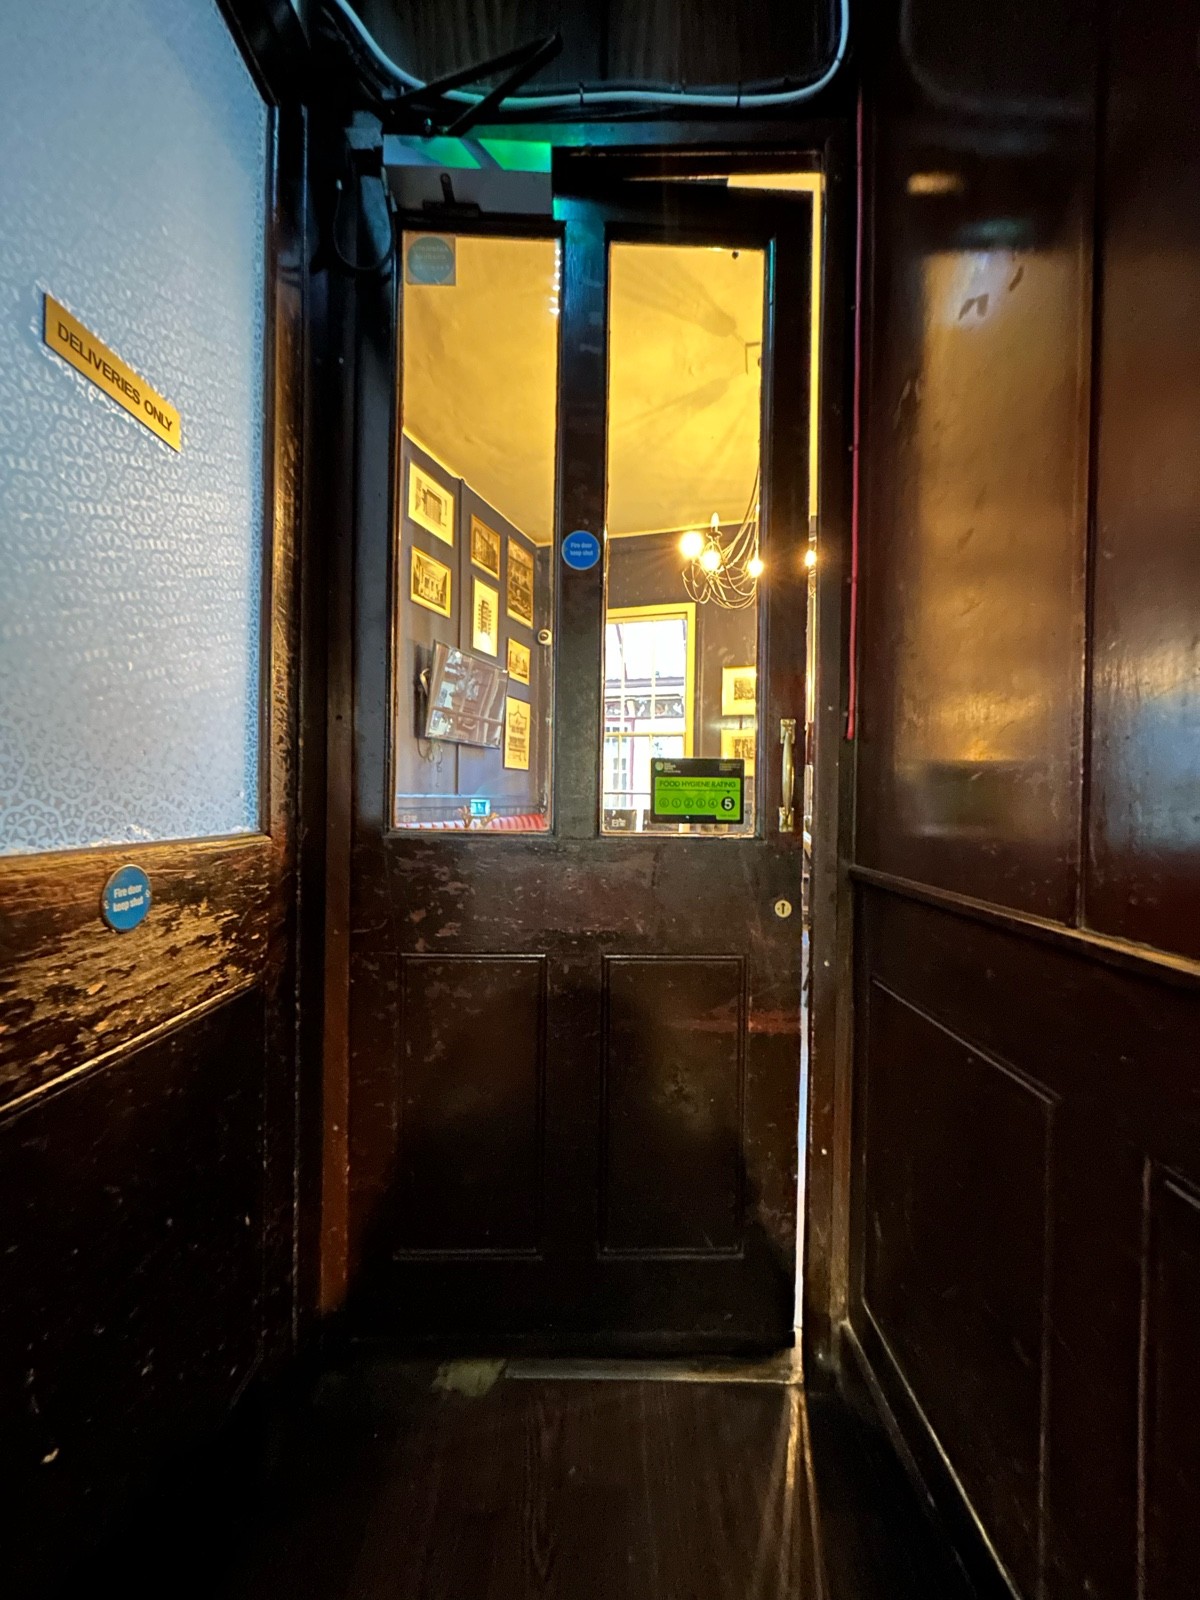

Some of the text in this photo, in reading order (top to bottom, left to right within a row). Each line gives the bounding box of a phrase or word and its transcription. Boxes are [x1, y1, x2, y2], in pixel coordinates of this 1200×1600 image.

[57, 320, 173, 432] DELIVERIES ONLY
[659, 780, 681, 788] FOOD
[681, 780, 710, 788] HYGIENE
[723, 798, 732, 810] 5
[113, 885, 142, 898] Fire door
